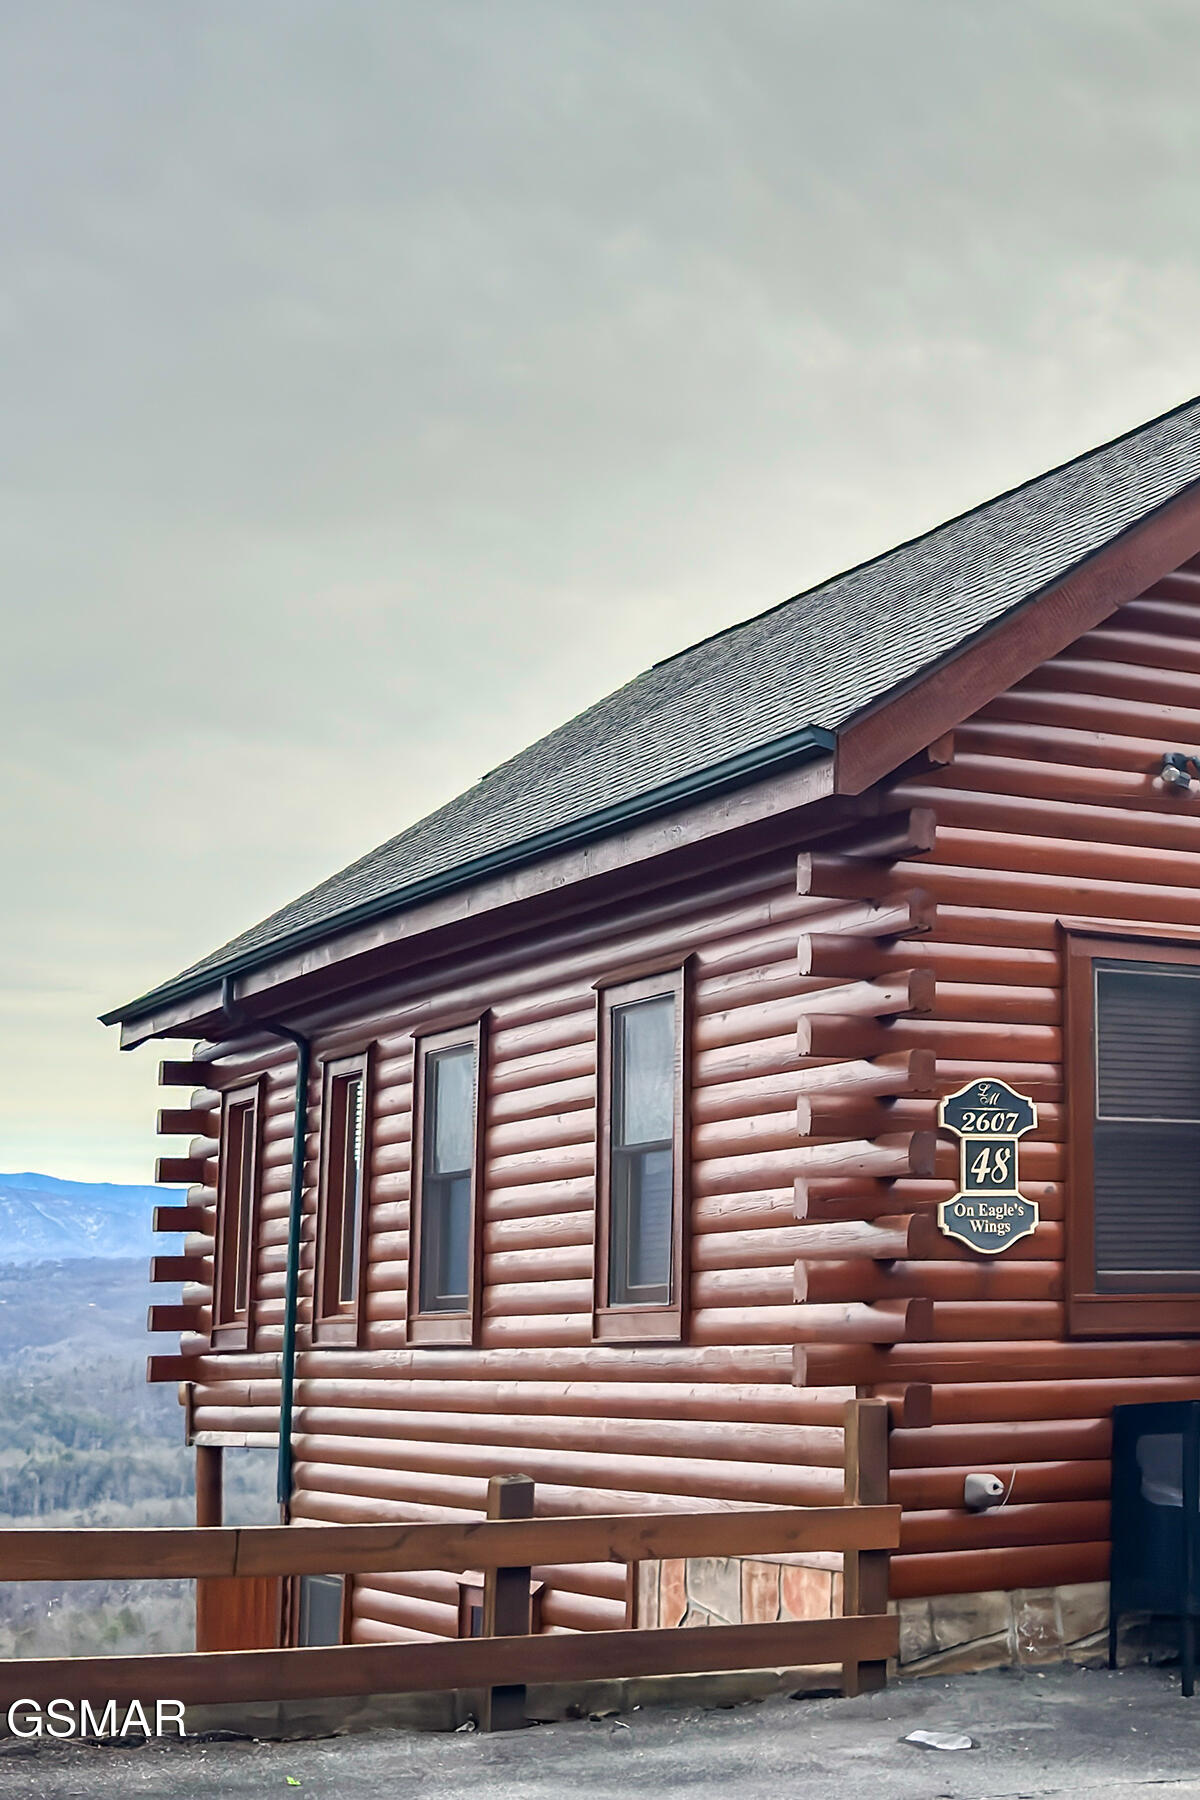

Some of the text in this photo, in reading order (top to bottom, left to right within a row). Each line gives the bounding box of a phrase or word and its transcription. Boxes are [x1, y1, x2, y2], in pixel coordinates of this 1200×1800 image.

[961, 1112, 1019, 1132] 2607
[970, 1147, 1011, 1183] 48
[954, 1203, 1024, 1220] On Eagle's
[970, 1220, 1011, 1236] Wings
